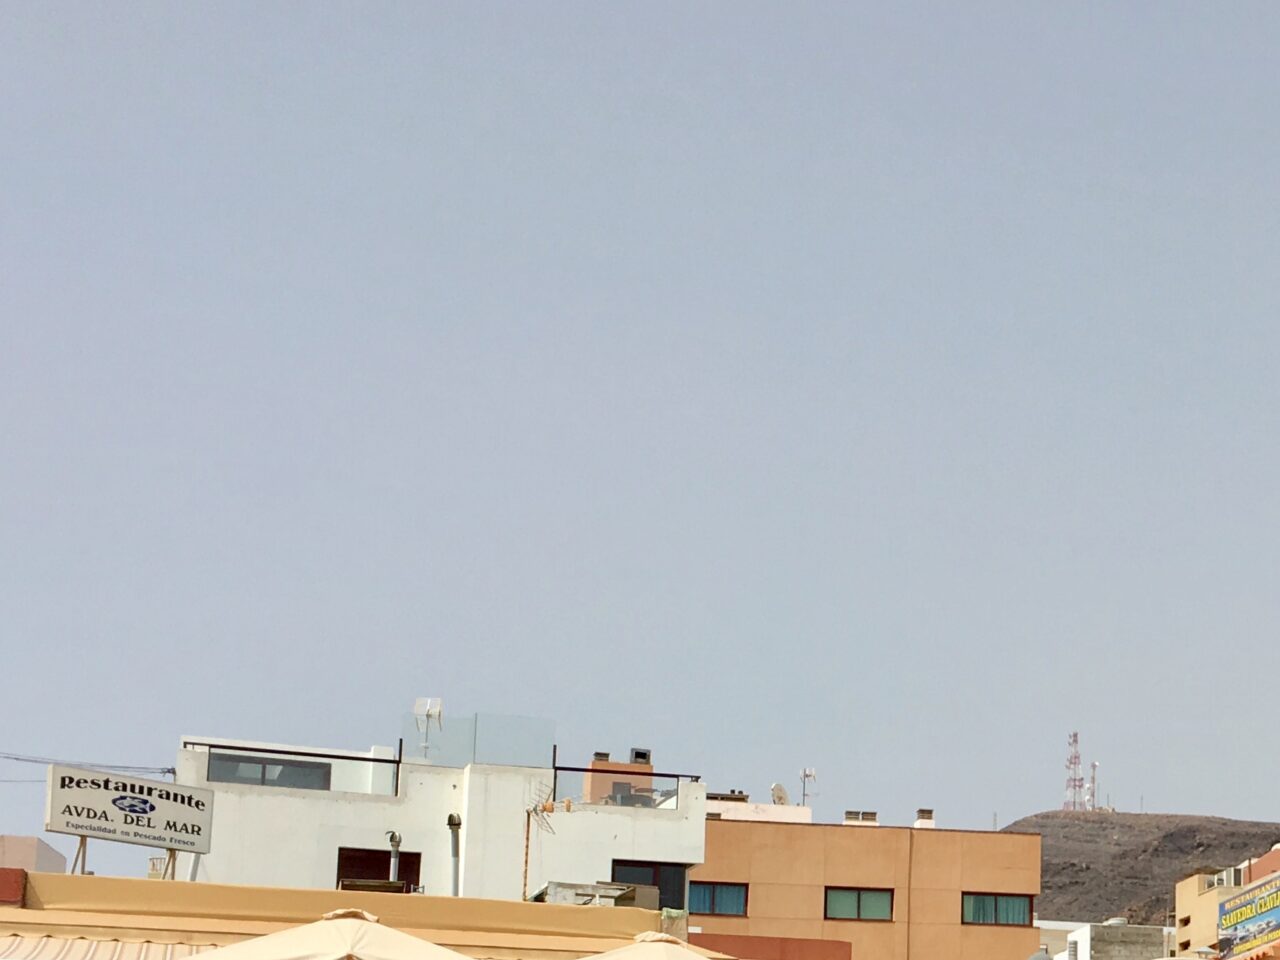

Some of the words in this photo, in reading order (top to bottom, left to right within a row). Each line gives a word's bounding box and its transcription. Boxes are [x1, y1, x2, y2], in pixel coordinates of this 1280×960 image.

[60, 775, 206, 812] Restaurante
[61, 804, 114, 823] AVDA.
[123, 813, 157, 829] DEL
[164, 820, 201, 836] MAR
[65, 821, 117, 835] Especialidad
[133, 831, 166, 843] Pescado
[169, 836, 195, 847] Fresco
[1221, 903, 1256, 930] SAAVEDRA
